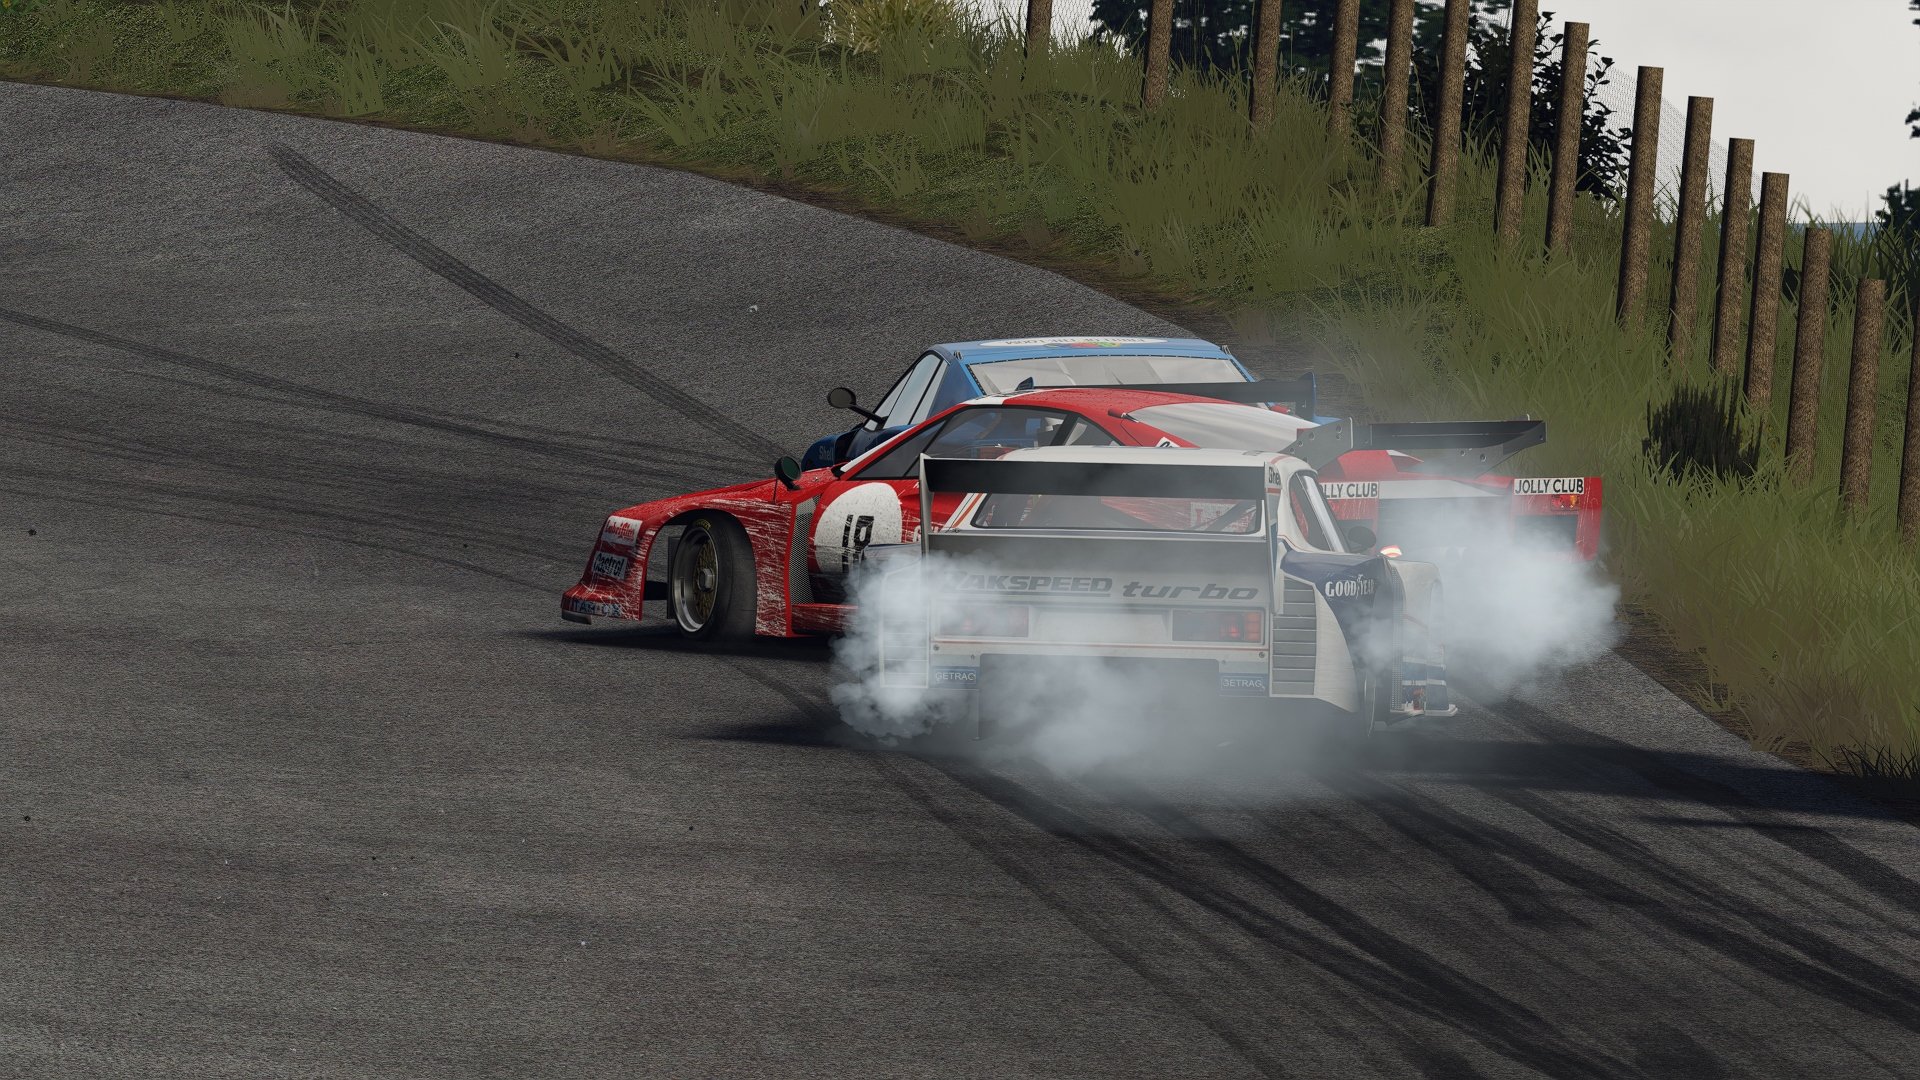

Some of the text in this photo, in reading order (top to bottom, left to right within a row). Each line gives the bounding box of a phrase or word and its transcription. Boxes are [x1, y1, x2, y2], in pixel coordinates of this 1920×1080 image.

[1346, 483, 1378, 498] CLUB
[1515, 479, 1584, 494] JOLLY CLUB
[1122, 581, 1258, 600] turbo
[936, 671, 976, 681] GETRAG
[1223, 679, 1262, 688] GETRAG
